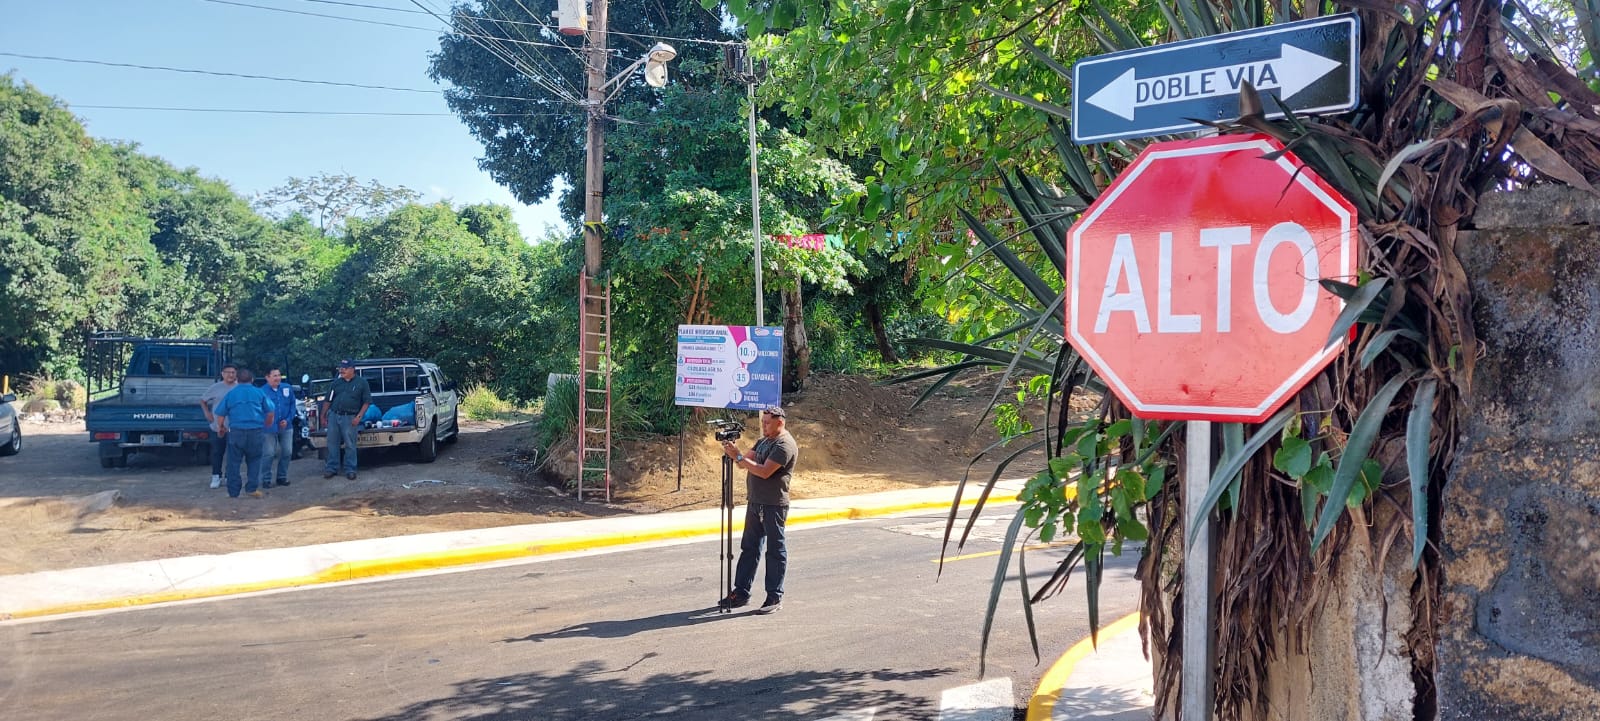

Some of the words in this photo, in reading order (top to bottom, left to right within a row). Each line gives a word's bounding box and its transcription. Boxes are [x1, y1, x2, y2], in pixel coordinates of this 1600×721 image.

[1136, 71, 1216, 103] DOBLE
[1226, 63, 1278, 90] VIA
[1094, 222, 1320, 334] ALTO
